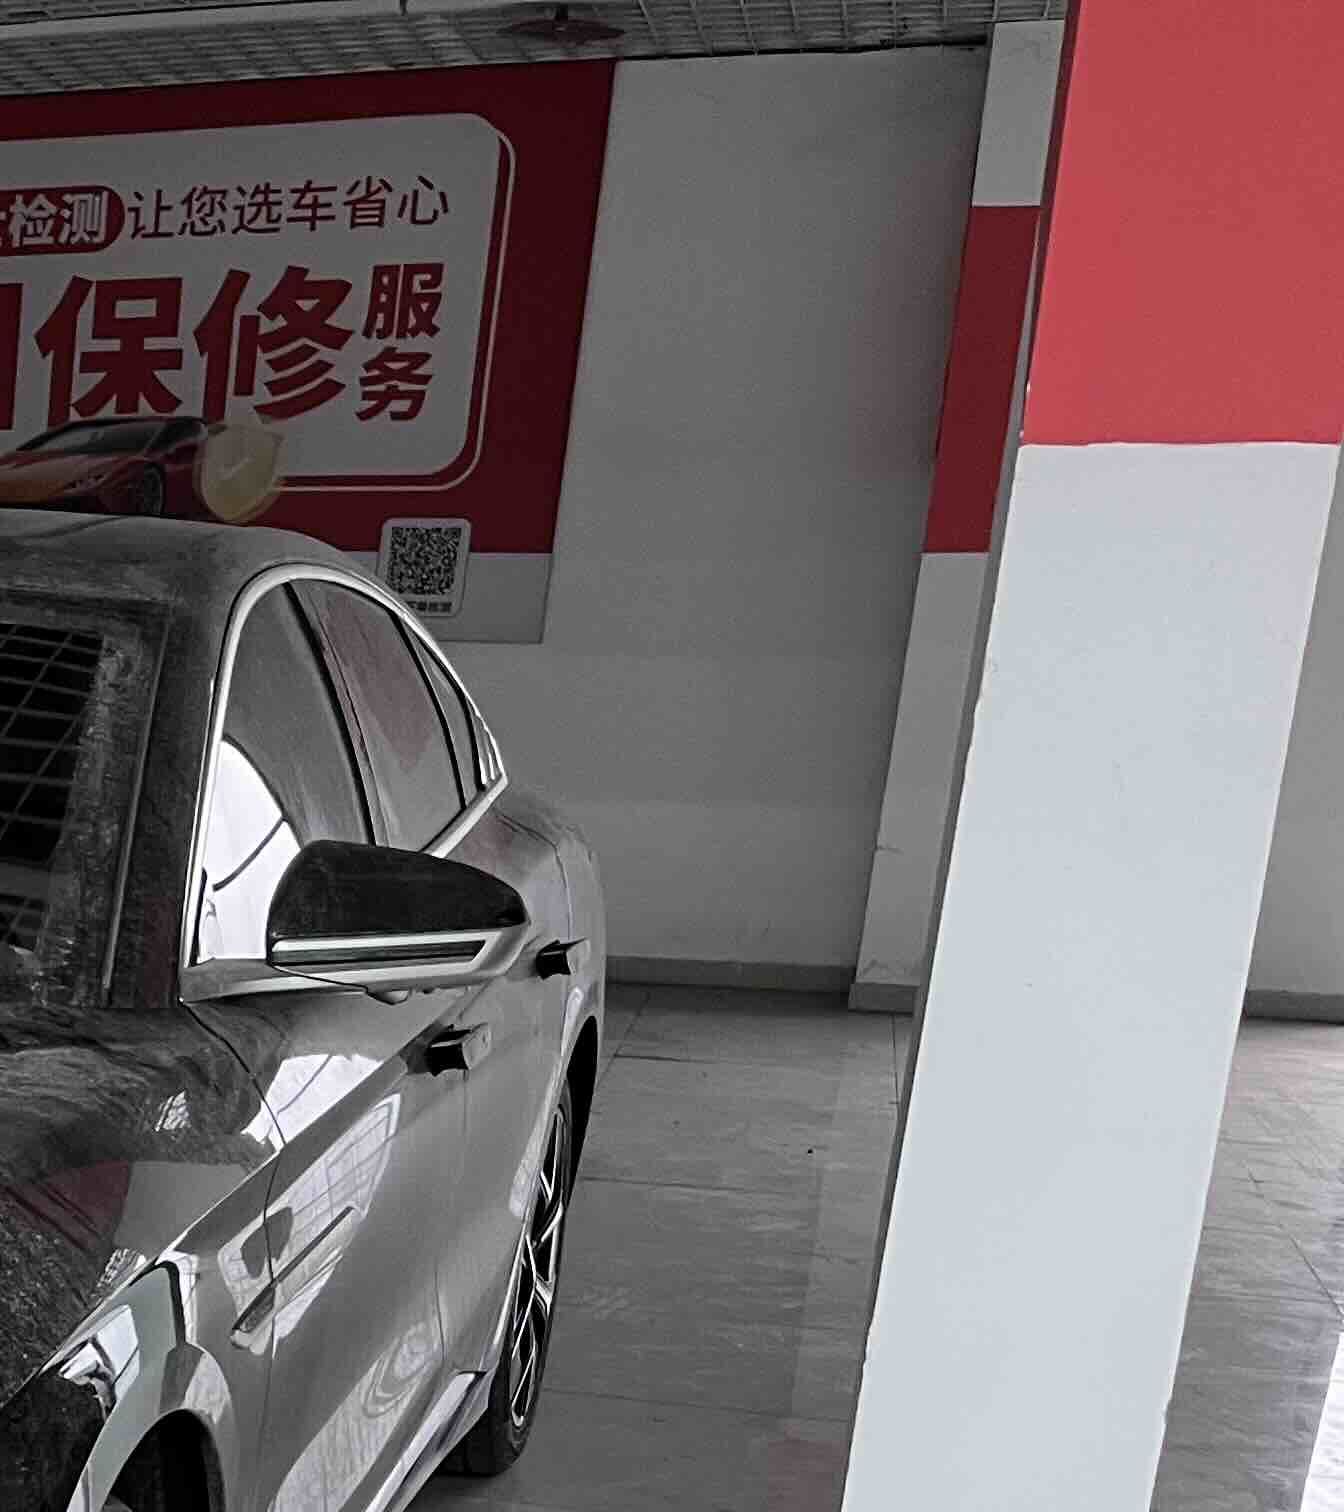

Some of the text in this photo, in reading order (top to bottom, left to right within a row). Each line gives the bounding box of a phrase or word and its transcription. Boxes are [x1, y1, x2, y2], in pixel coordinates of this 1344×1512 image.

[127, 174, 449, 240] 让您选车省心
